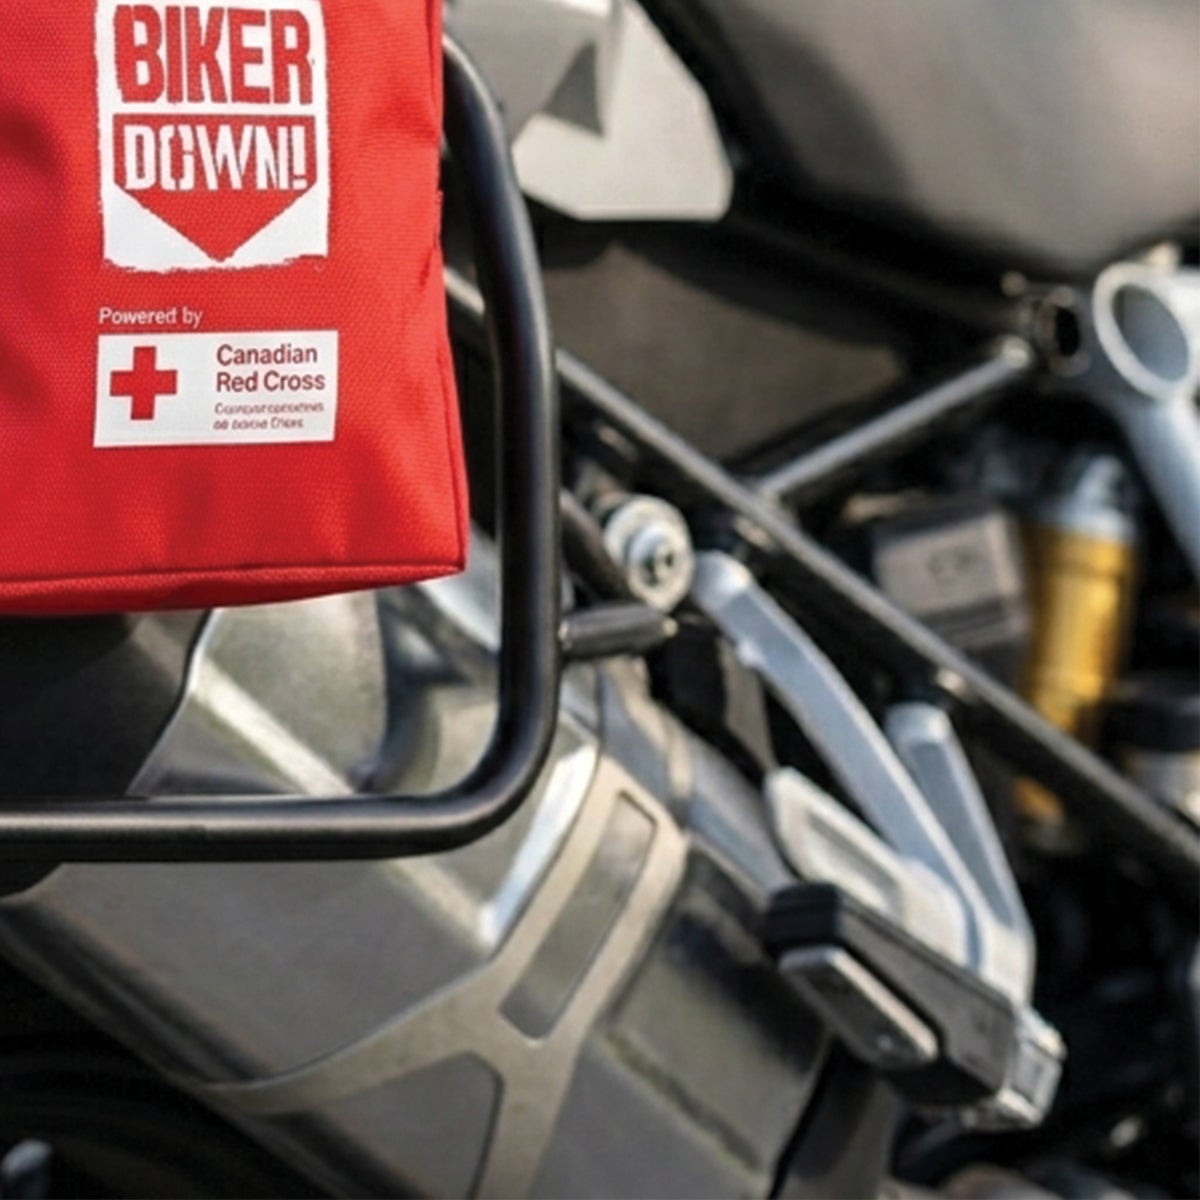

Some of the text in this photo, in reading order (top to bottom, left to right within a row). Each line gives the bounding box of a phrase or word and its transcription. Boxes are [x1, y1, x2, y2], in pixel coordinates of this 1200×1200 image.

[113, 4, 313, 105] BIKER
[123, 124, 308, 191] DOWN!
[99, 306, 203, 329] Powered by
[216, 343, 318, 367] Canadian
[216, 370, 326, 393] Red Cross
